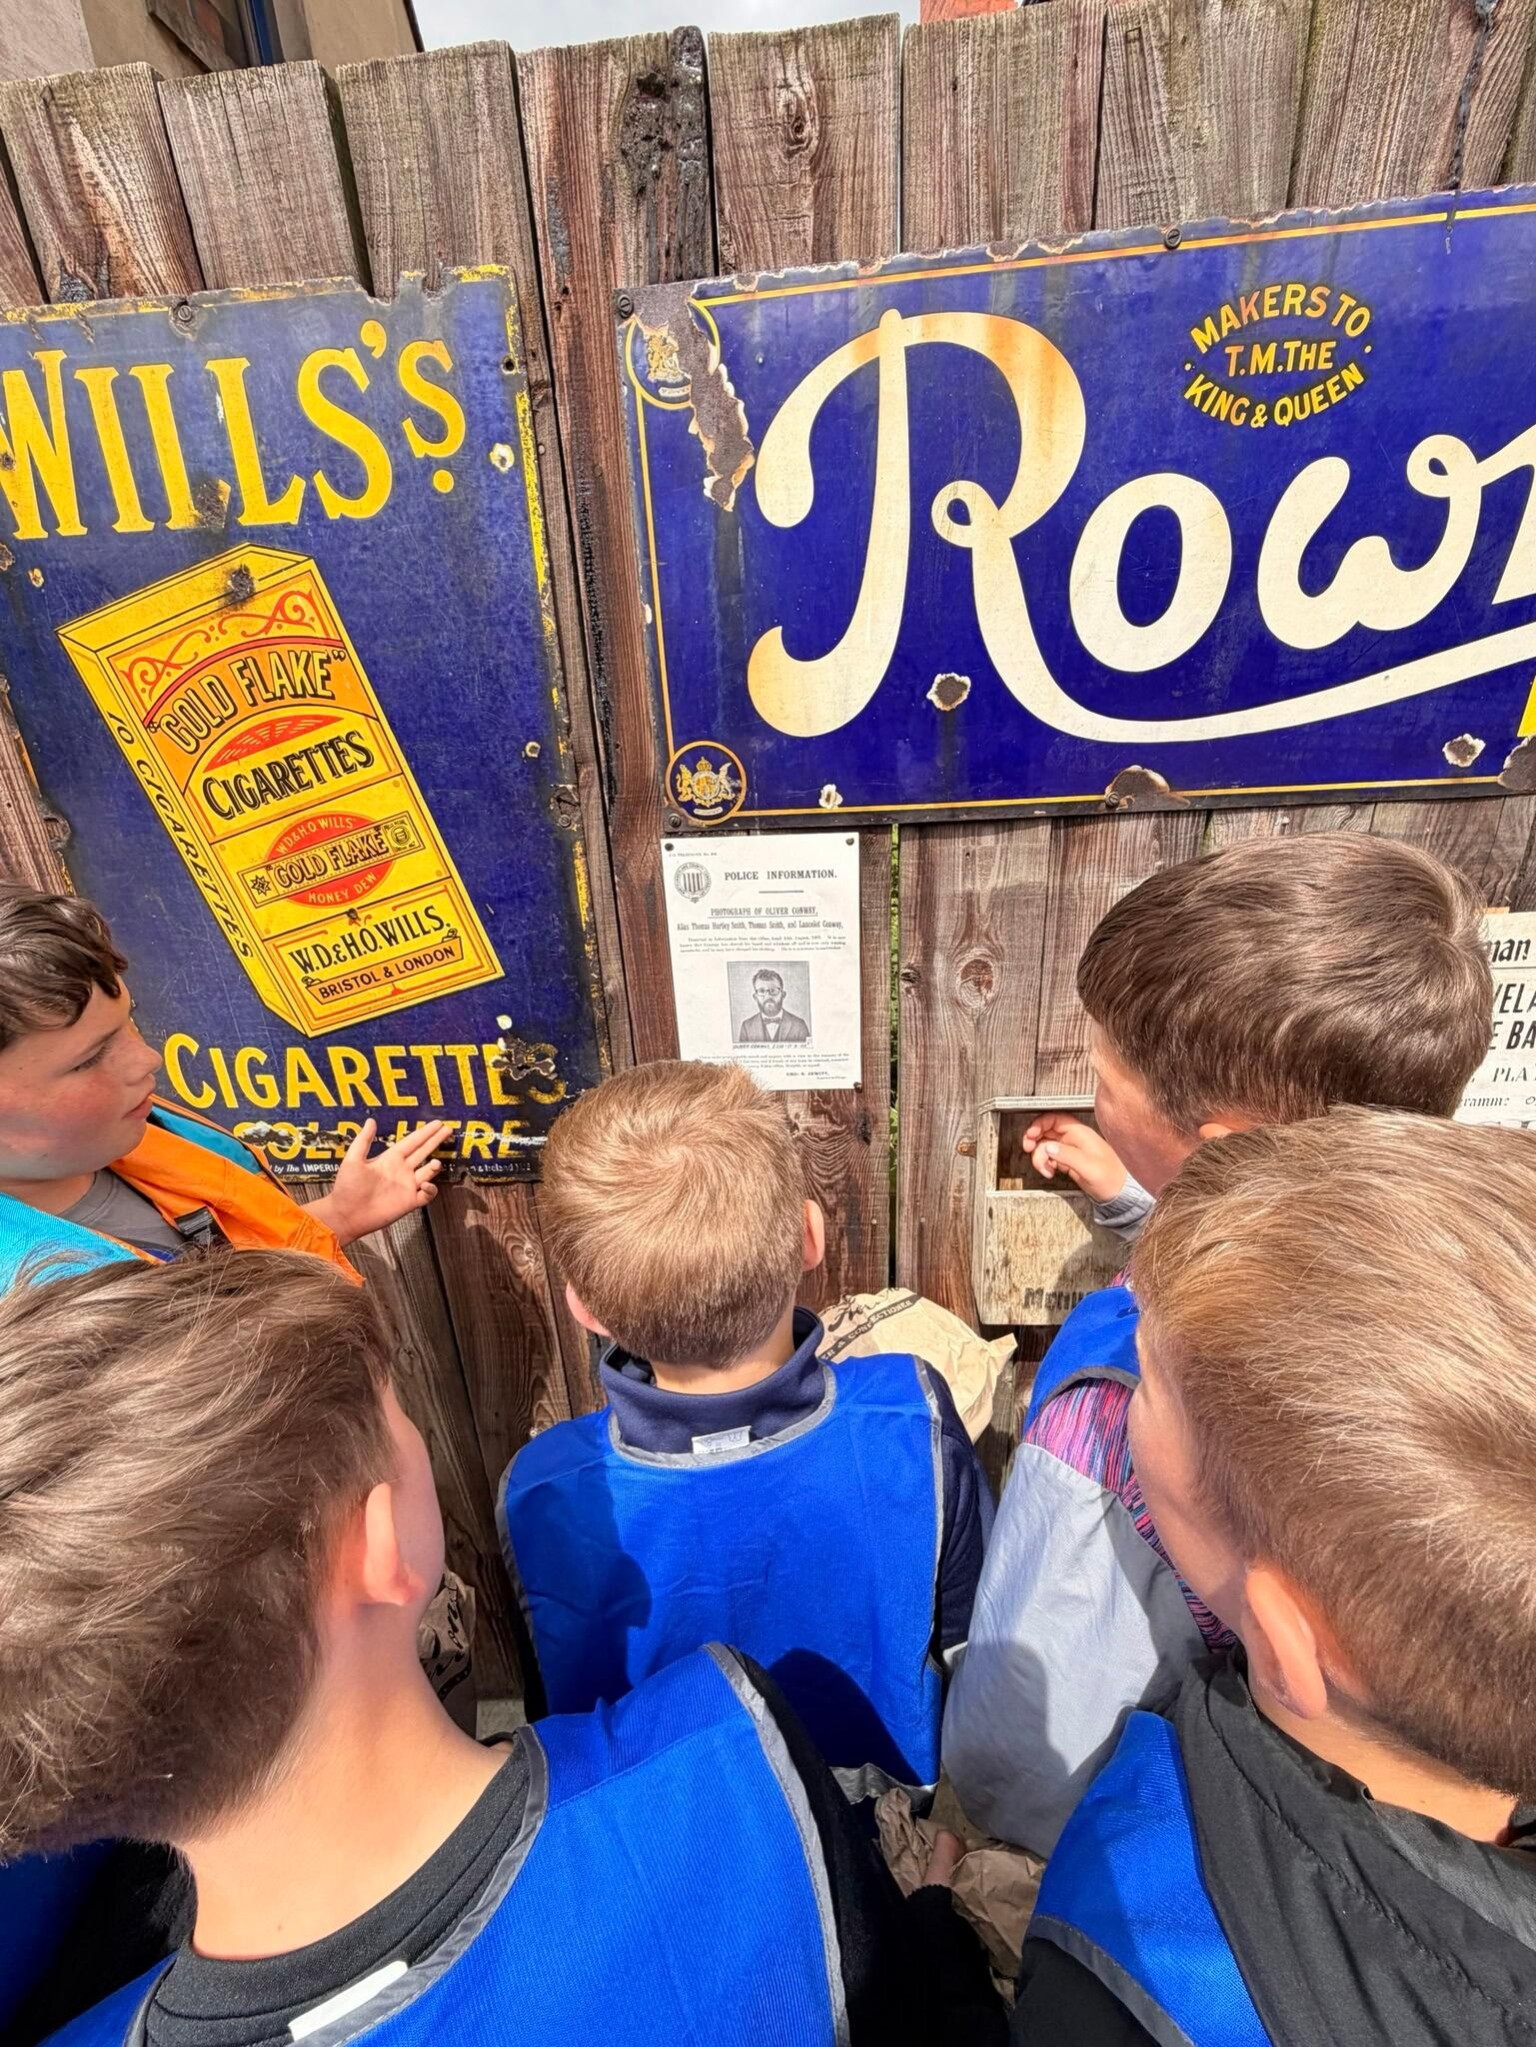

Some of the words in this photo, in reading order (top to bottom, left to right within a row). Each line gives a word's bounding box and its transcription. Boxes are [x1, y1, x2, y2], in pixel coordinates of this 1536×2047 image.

[1190, 283, 1331, 354] MAKERS
[1331, 293, 1371, 338] TO
[1183, 374, 1250, 427] KING
[1251, 403, 1269, 428] &
[1274, 362, 1365, 427] QUEEN
[202, 730, 375, 821] CIGARETTES
[107, 710, 135, 746] 10
[136, 759, 254, 959] CIGARETTES
[308, 888, 350, 904] HONEY
[353, 871, 378, 894] DEW
[724, 871, 759, 881] POLICE
[766, 869, 838, 880] INFORMATION.
[710, 907, 751, 917] PHOTOGRAPH
[318, 971, 381, 999] BRISTOL
[383, 966, 394, 979] &
[396, 945, 456, 974] LONDON
[1493, 1066, 1536, 1082] PLA
[274, 1164, 284, 1174] by
[286, 1163, 300, 1172] The
